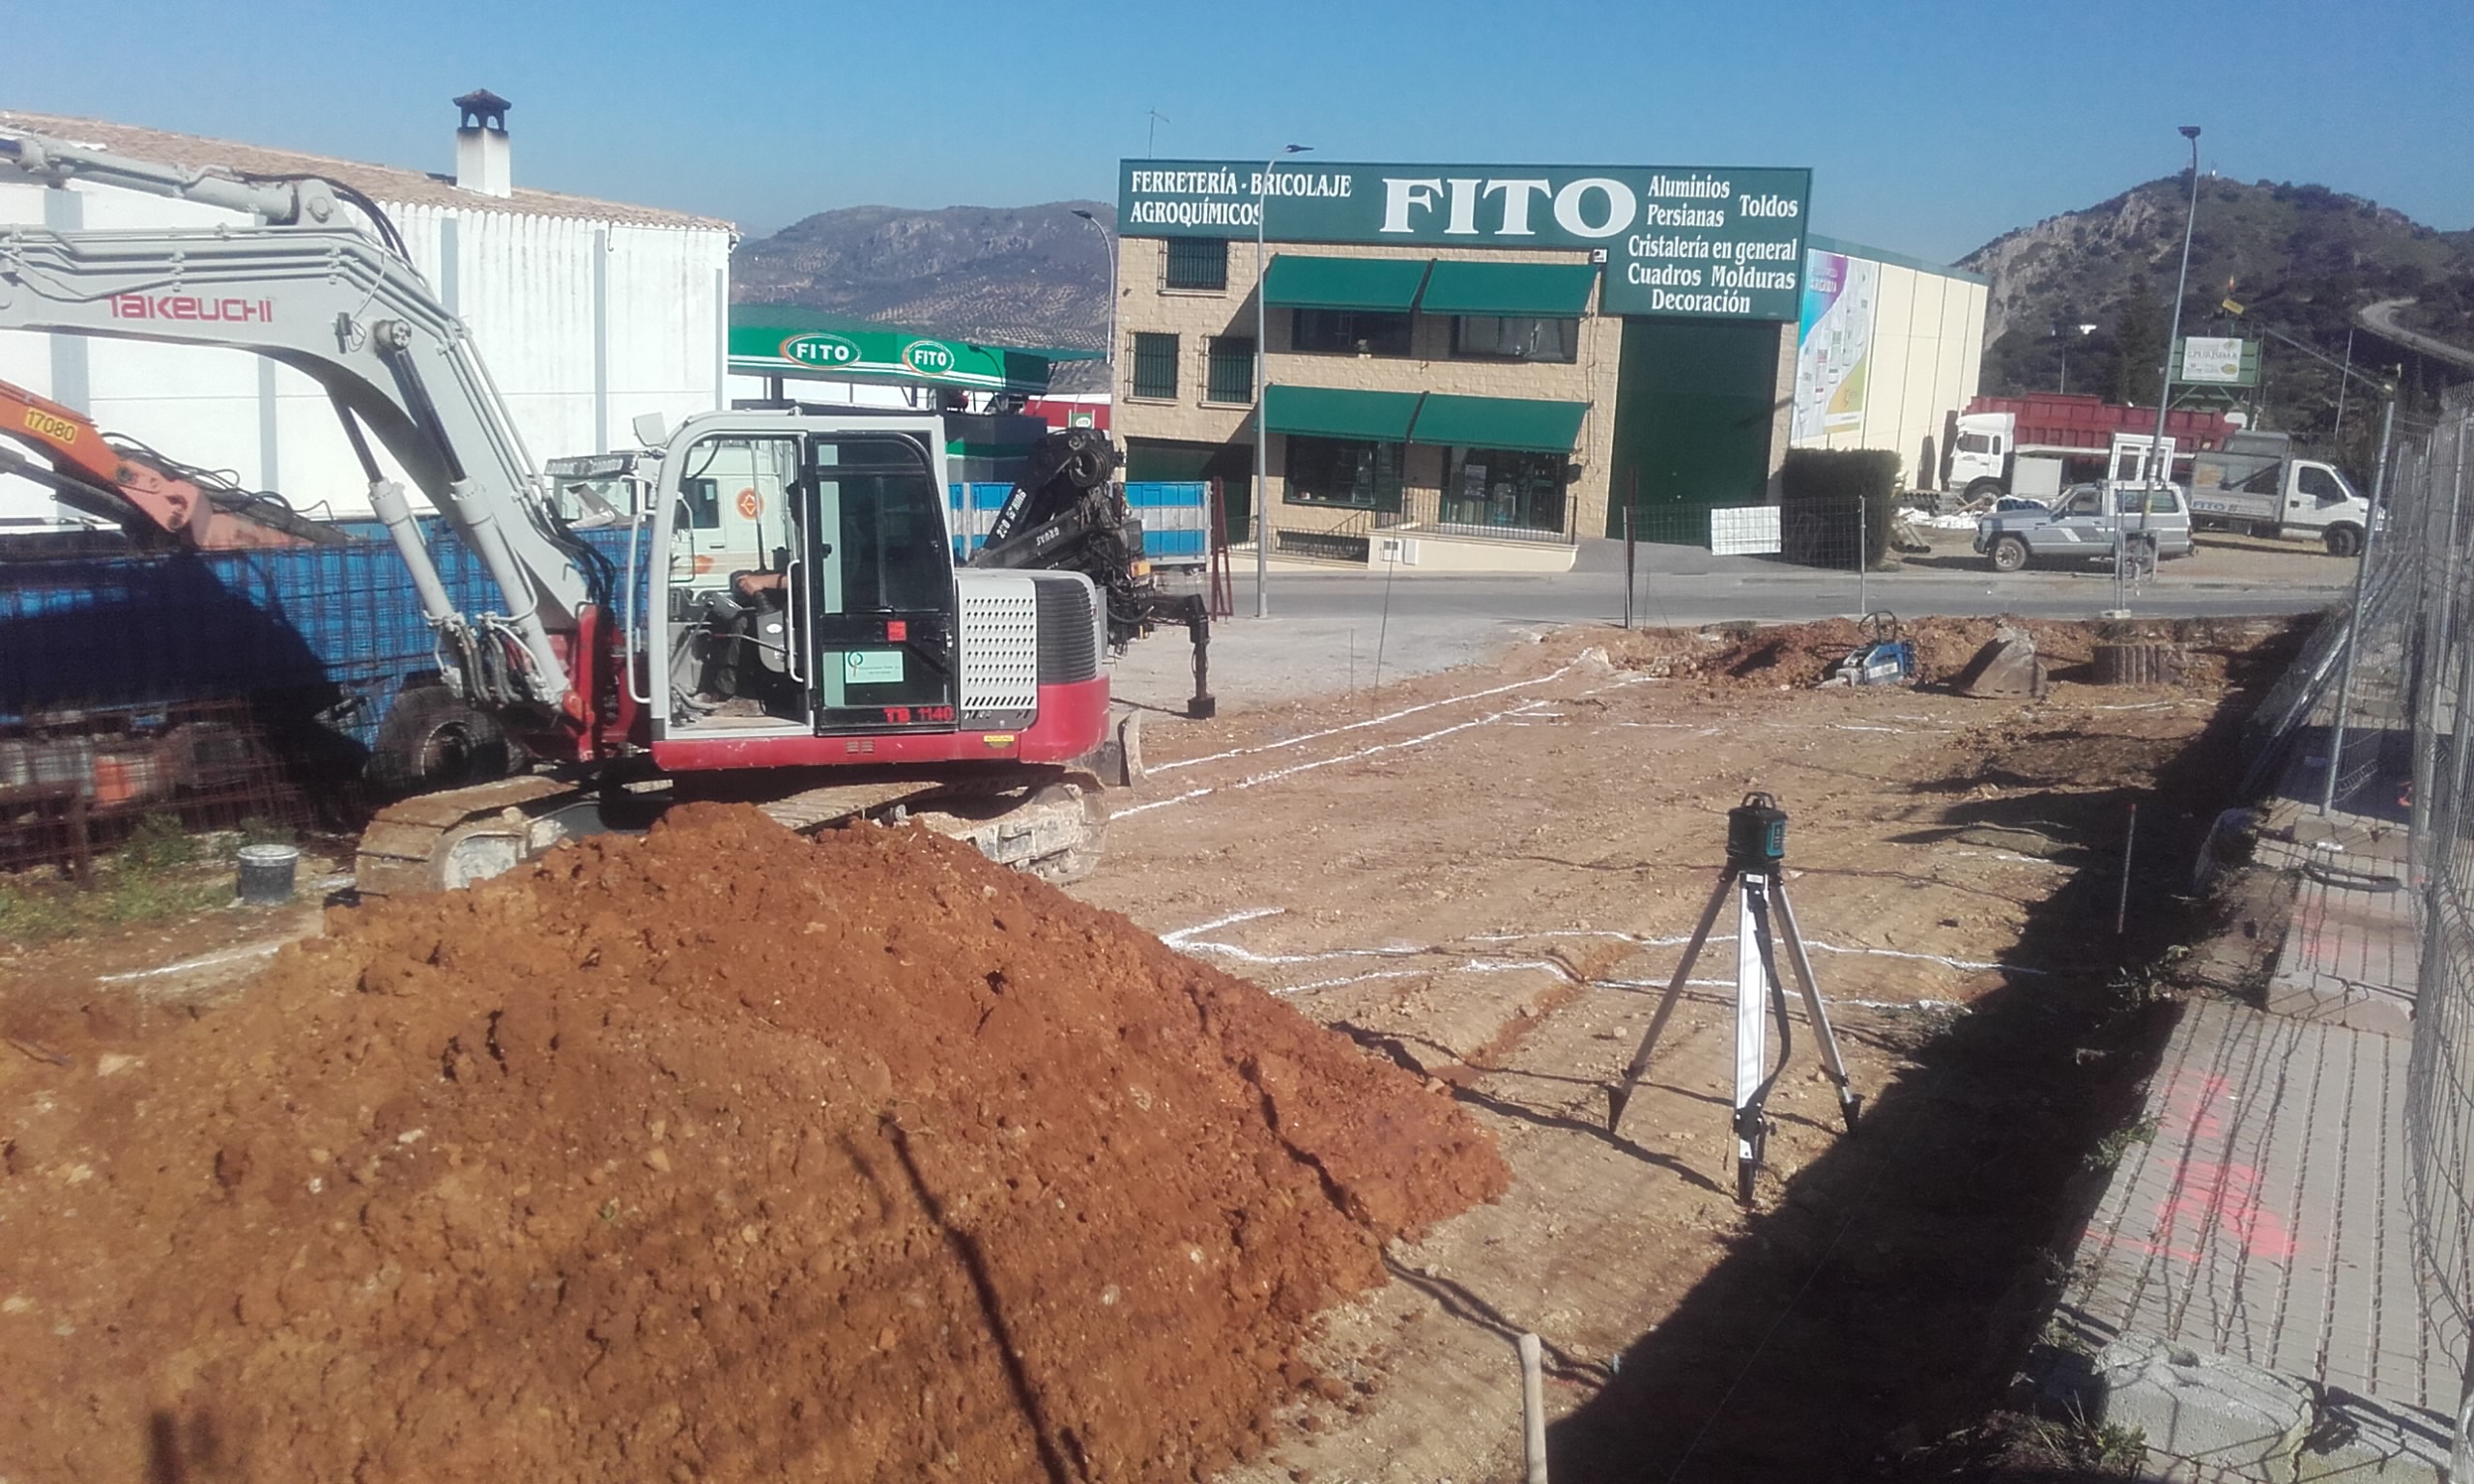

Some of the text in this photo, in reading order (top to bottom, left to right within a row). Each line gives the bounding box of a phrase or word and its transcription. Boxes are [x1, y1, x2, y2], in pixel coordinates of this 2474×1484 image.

[1132, 166, 1238, 194] FERRETERÍA
[1251, 172, 1352, 197] BRICOLAJE
[1648, 174, 1730, 199] Aluminios
[1379, 178, 1637, 238] FITO
[1647, 203, 1725, 228] Persianas
[1740, 194, 1798, 217] Toldos
[1627, 234, 1798, 266] Cristalería en general
[1627, 263, 1702, 287] Cuadros
[1711, 265, 1796, 290] Molduras
[1652, 289, 1751, 313] Decoración
[796, 342, 850, 362] FITO
[914, 350, 947, 367] FITO
[28, 411, 76, 442] 17080
[2193, 500, 2226, 510] FITO
[883, 706, 954, 724] TB 1140
